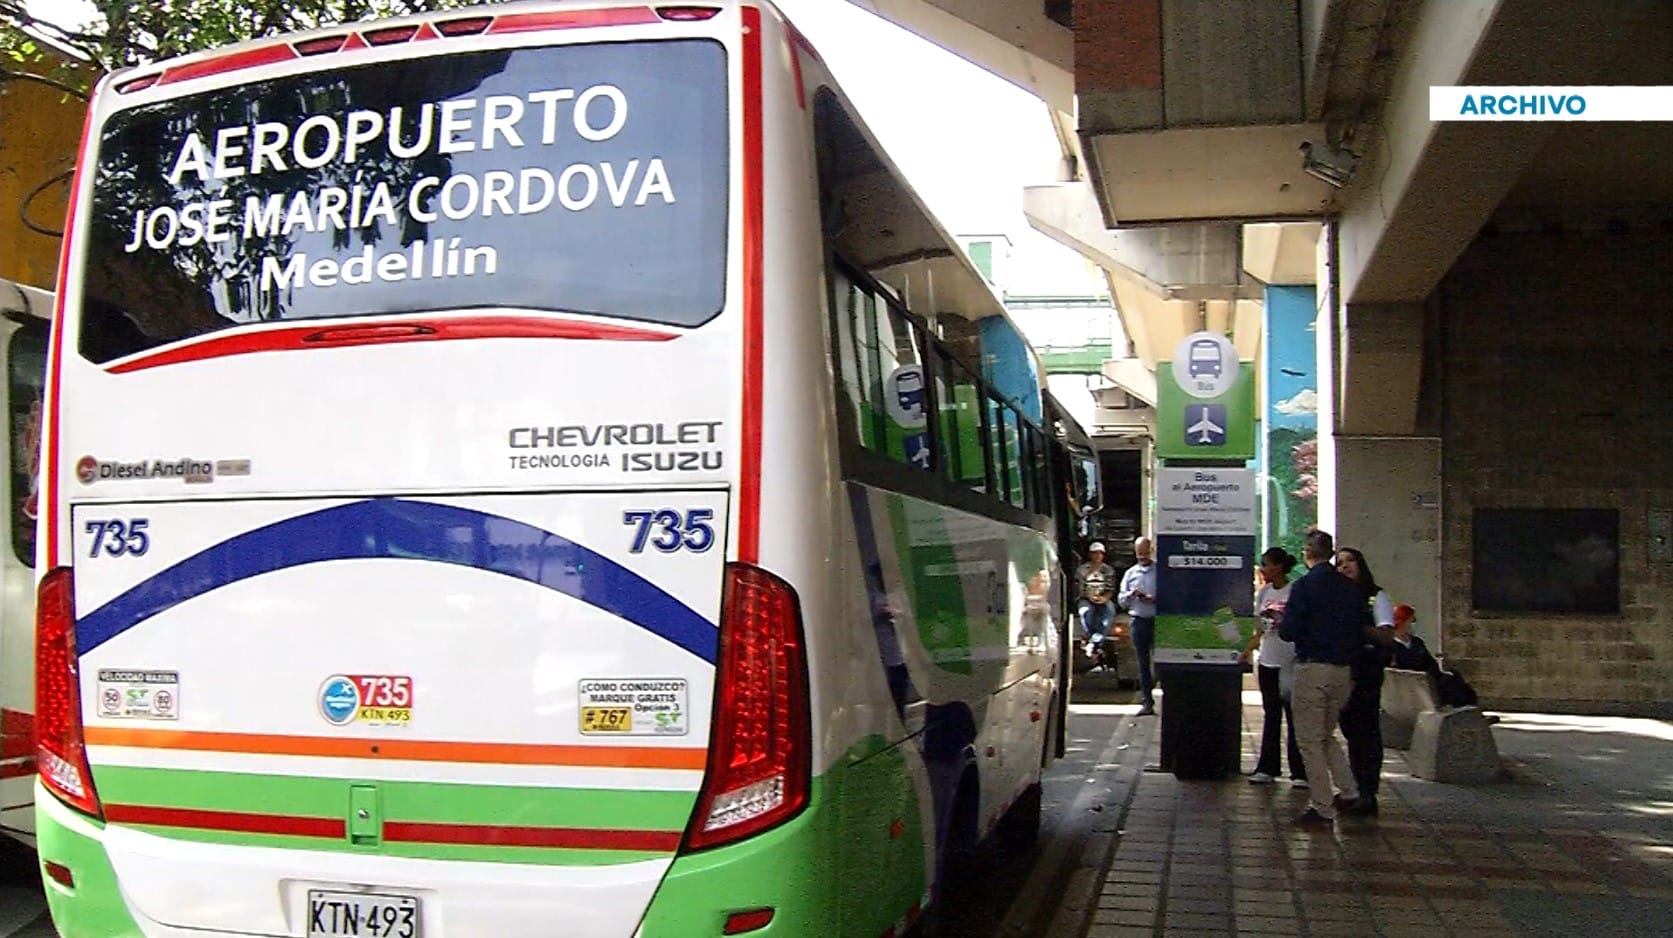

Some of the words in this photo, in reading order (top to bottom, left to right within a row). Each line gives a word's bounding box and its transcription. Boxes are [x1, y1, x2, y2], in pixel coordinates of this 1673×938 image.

[169, 84, 627, 185] AEROPUERTO
[126, 199, 231, 253] JOSÉ
[244, 169, 398, 240] MARÍA
[410, 158, 676, 224] CORDOVA
[261, 239, 497, 291] Medellín
[509, 421, 723, 449] CHEVROLET
[100, 460, 148, 479] Diesel
[152, 459, 213, 476] Andino
[509, 454, 610, 470] TECNOLOGIA
[622, 451, 723, 472] ISUZU
[1194, 472, 1217, 482] Bus
[1192, 493, 1219, 504] MDE
[85, 518, 150, 558] 735
[623, 508, 715, 554] 735
[361, 677, 409, 706] 735
[620, 682, 685, 692] CONDUZCO?
[590, 694, 635, 703] MARQUE
[637, 693, 676, 703] GRATIS
[361, 709, 384, 719] KTN
[387, 710, 410, 720] 493
[600, 709, 627, 725] 767
